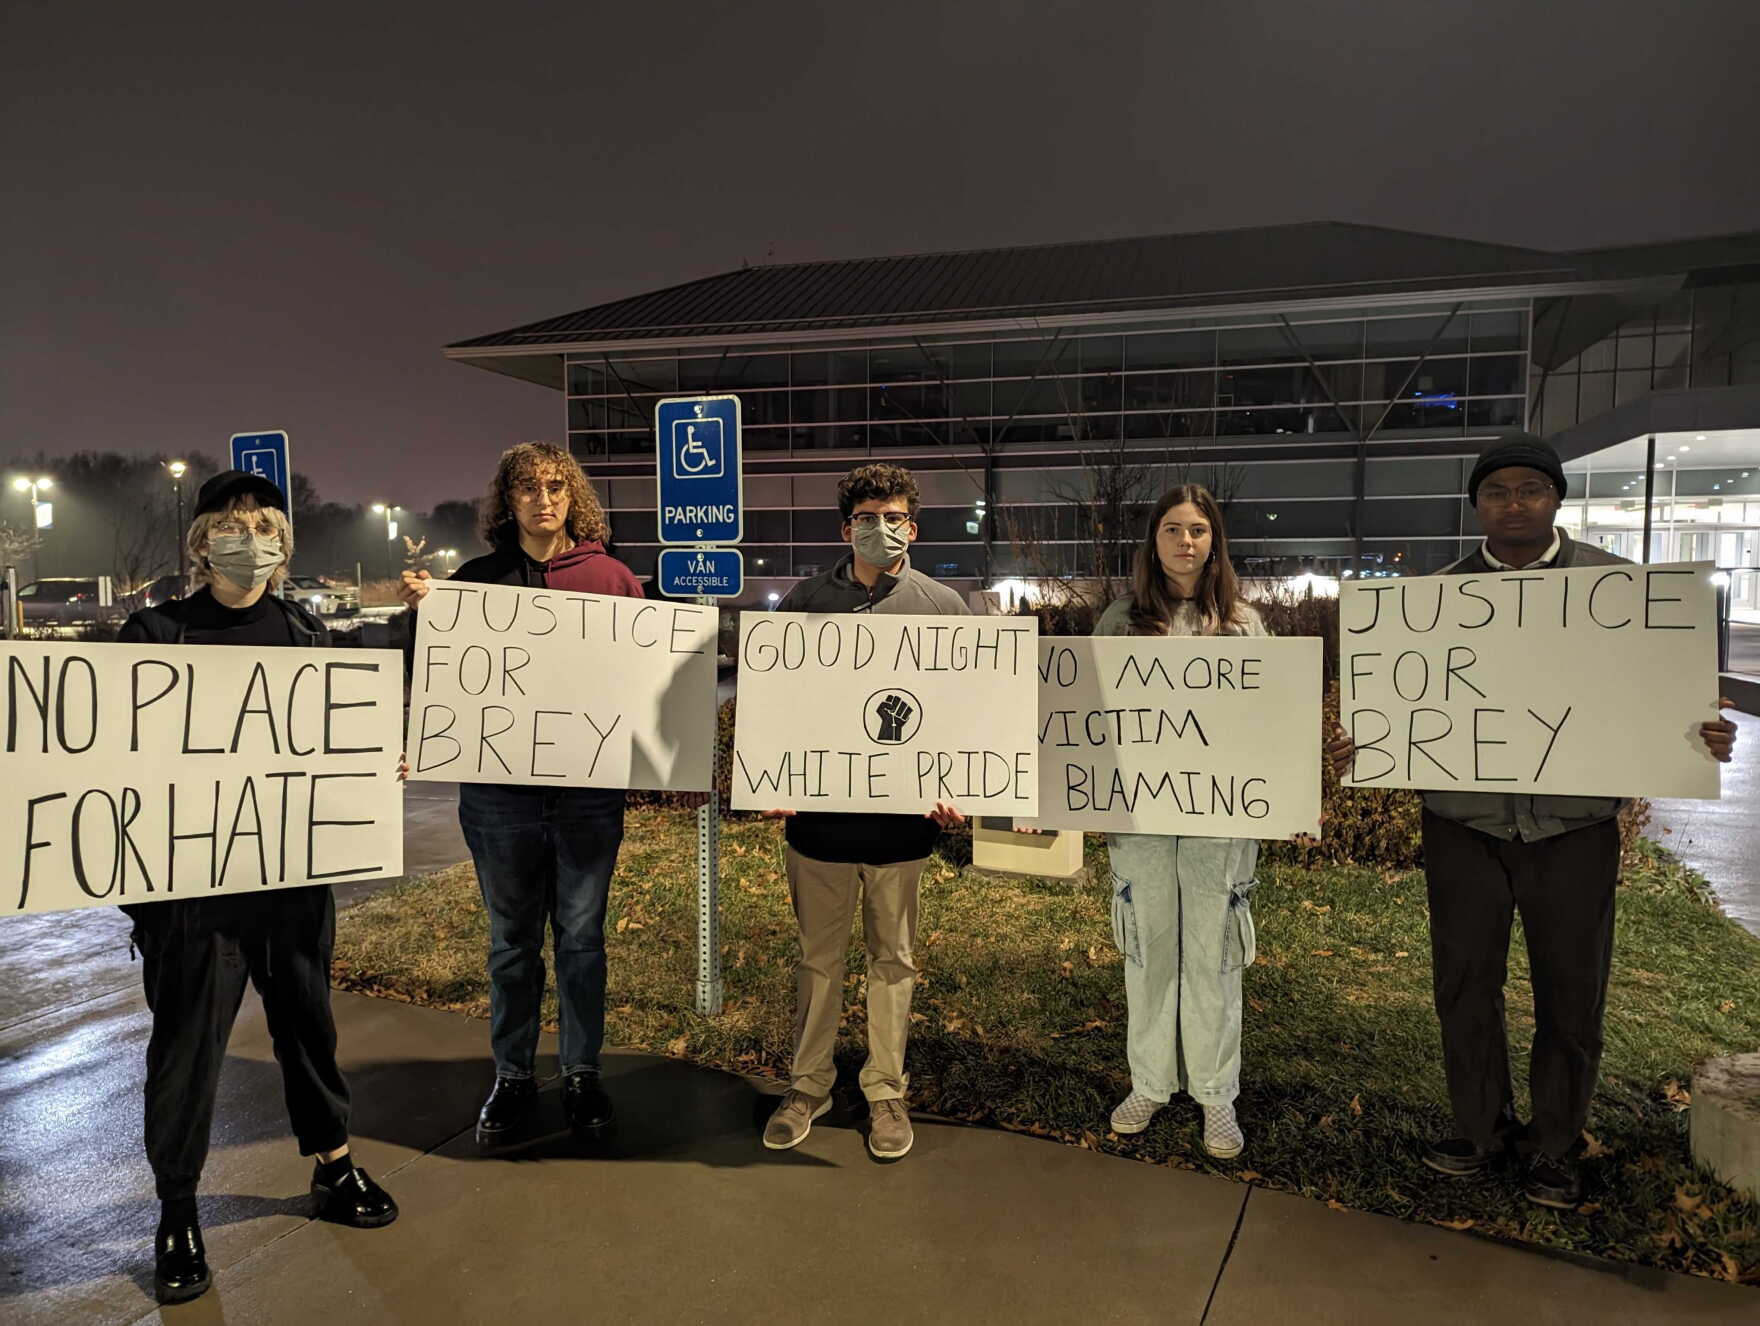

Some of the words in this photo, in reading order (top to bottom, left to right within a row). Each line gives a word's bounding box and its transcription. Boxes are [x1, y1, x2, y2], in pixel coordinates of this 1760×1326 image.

[665, 504, 735, 524] PARKING
[673, 576, 729, 586] ACCESSIBLE
[687, 559, 716, 574] VAN
[428, 587, 705, 654] JUSTICE
[1347, 570, 1696, 634] JUSTICE
[425, 645, 531, 697] FOR
[744, 619, 875, 673] GOOD
[893, 625, 1031, 676] NIGHT
[1115, 654, 1262, 690] MORE
[1350, 646, 1487, 702] FOR
[6, 655, 98, 754] NO
[129, 659, 383, 756] PLACE
[1037, 708, 1209, 746] VICTIM
[416, 704, 622, 779] BREY
[1351, 706, 1572, 784] BREY
[736, 750, 890, 798] WHITE
[916, 751, 1032, 800] PRIDE
[1066, 763, 1270, 819] BLAMING
[17, 787, 154, 910] FOR
[166, 771, 384, 893] HATE
